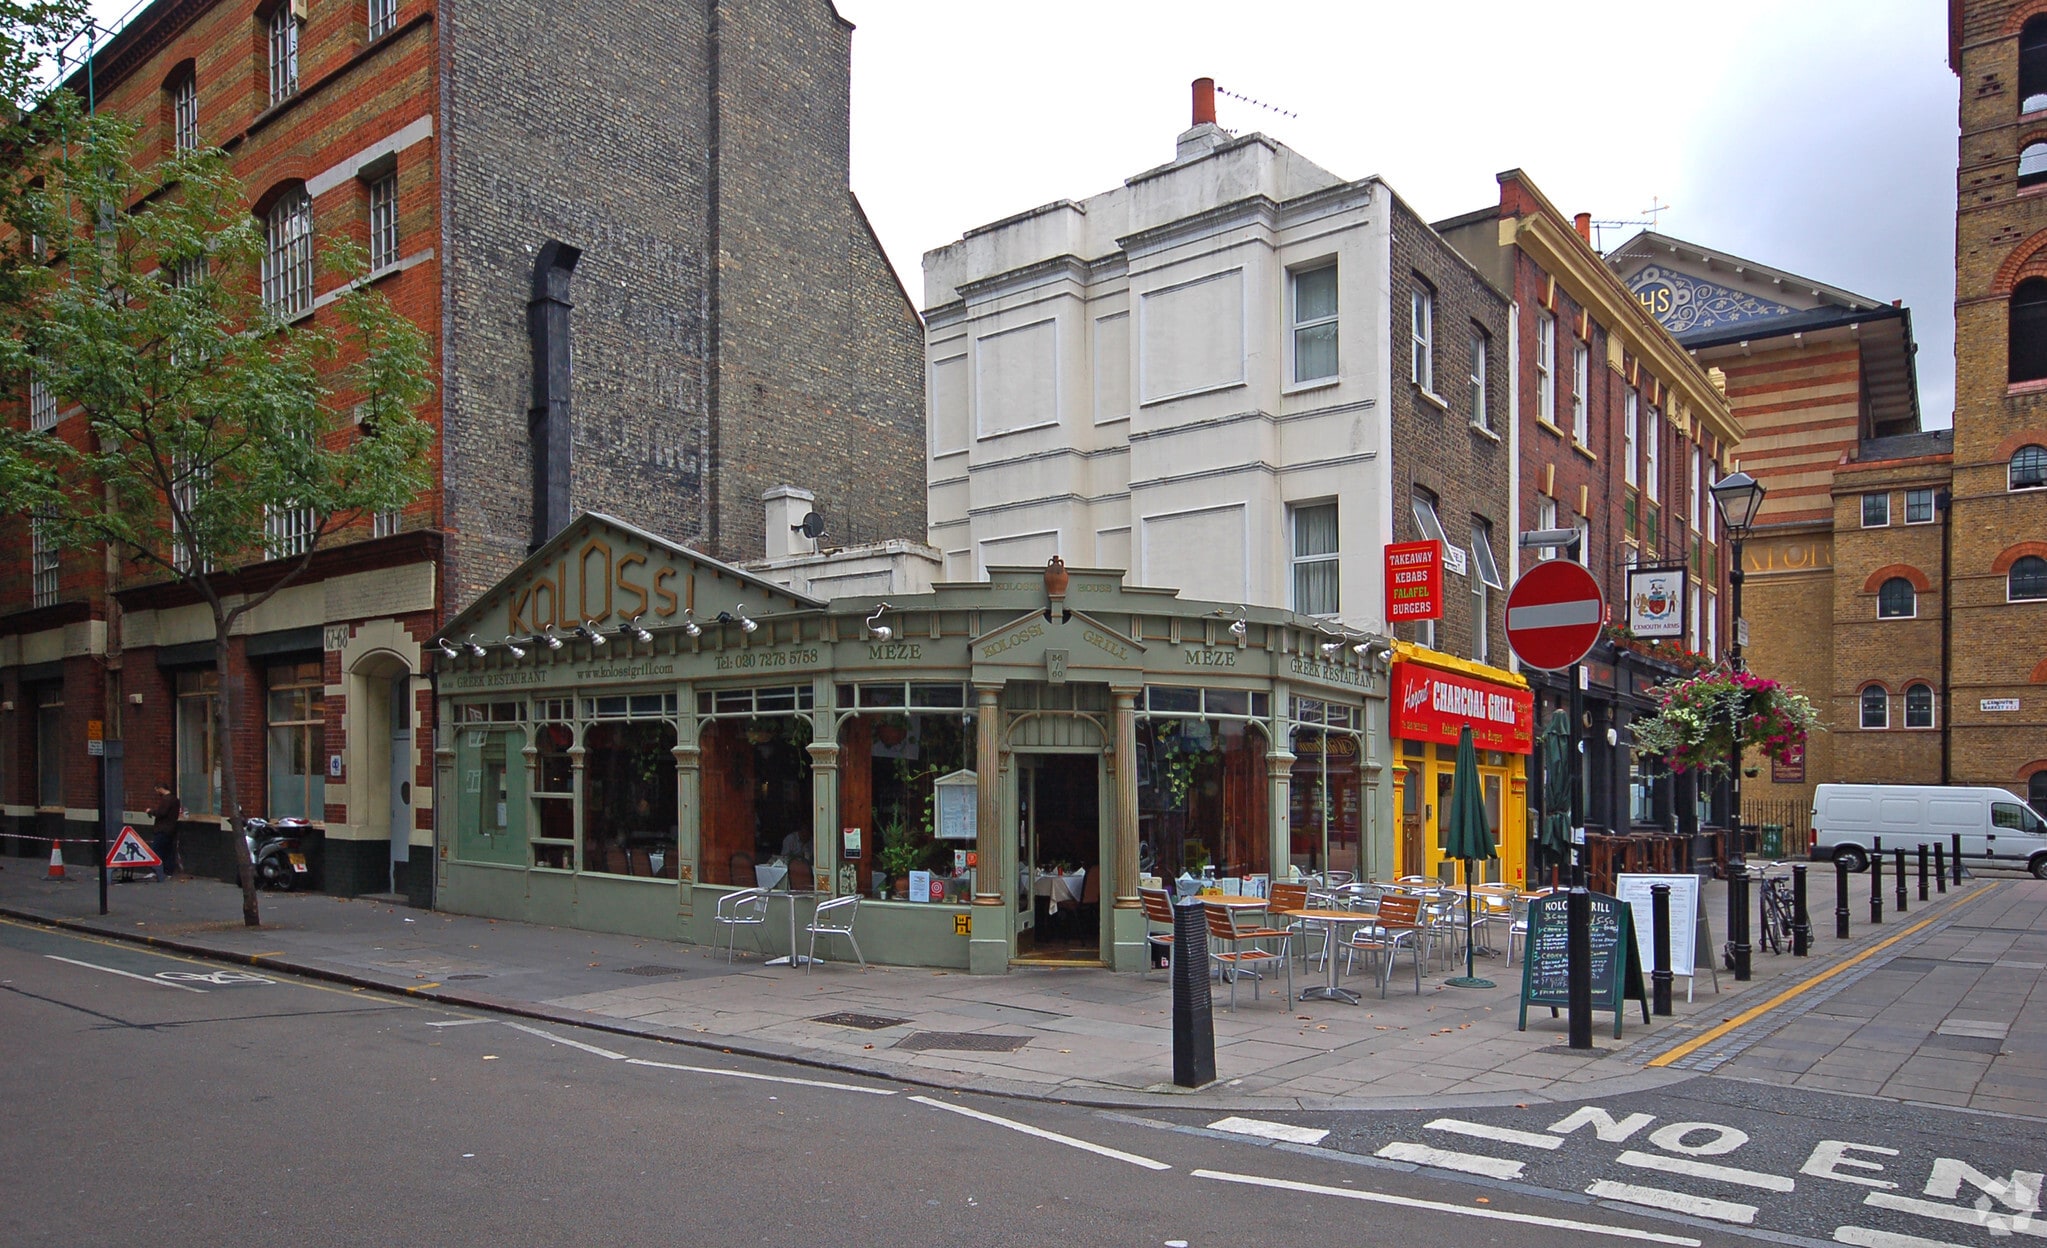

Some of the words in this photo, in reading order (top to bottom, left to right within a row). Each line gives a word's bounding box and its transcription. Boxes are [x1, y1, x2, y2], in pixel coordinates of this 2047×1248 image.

[1389, 552, 1432, 566] TAKEAWAY
[1395, 571, 1428, 583] KEBABS
[509, 538, 694, 634] KOLOSSI
[1393, 586, 1429, 599] FALAFEL
[1393, 602, 1431, 615] BURGERS
[982, 624, 1045, 659] KOLOSSI
[1083, 629, 1128, 661] GRILL
[714, 656, 733, 670] Tel:
[735, 654, 755, 669] 020
[758, 652, 786, 667] 7278
[788, 649, 818, 664] 5758
[869, 643, 922, 660] MEZE
[1185, 650, 1236, 667] MEZE
[457, 675, 485, 689] GREEK
[488, 670, 547, 687] RESTAURANT
[577, 663, 673, 680] www.kolossigrill.com
[1290, 658, 1321, 678] GREEK
[1323, 666, 1377, 689] RESTAURANT
[1433, 681, 1486, 719] CHARCOAL
[1488, 693, 1515, 724] GRILL
[1591, 902, 1611, 913] RILL
[1546, 1106, 1749, 1157] NO
